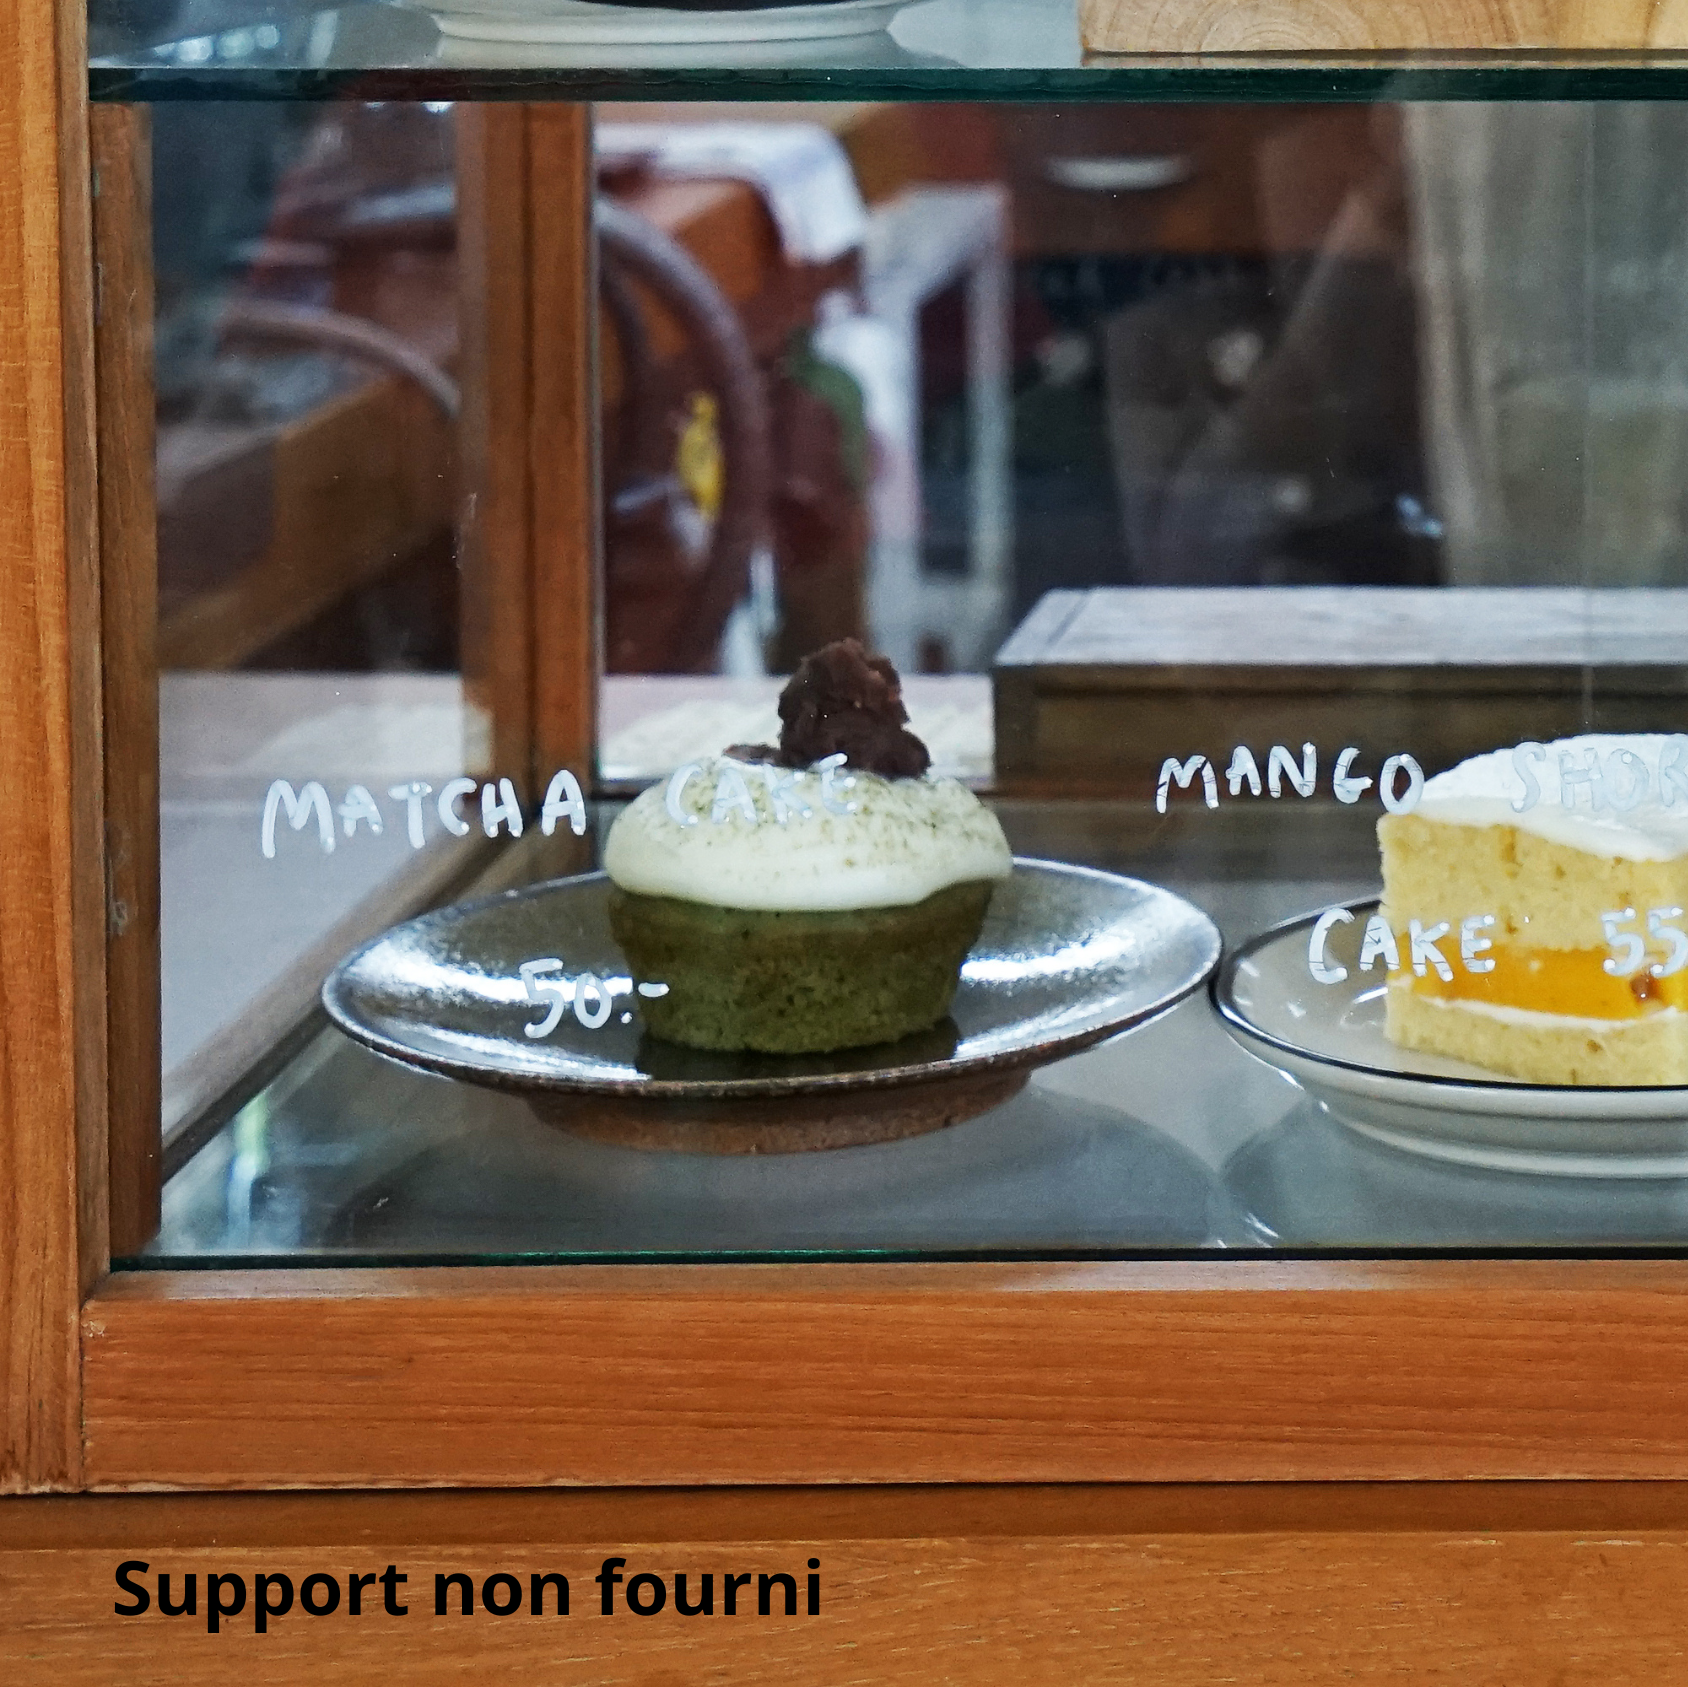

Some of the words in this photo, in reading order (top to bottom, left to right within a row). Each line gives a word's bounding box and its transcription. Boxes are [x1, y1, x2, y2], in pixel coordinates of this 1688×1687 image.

[261, 768, 589, 860] MATCHA
[665, 752, 858, 826] CAKE
[1155, 741, 1425, 816] MANGO
[1308, 907, 1497, 986] CAKE
